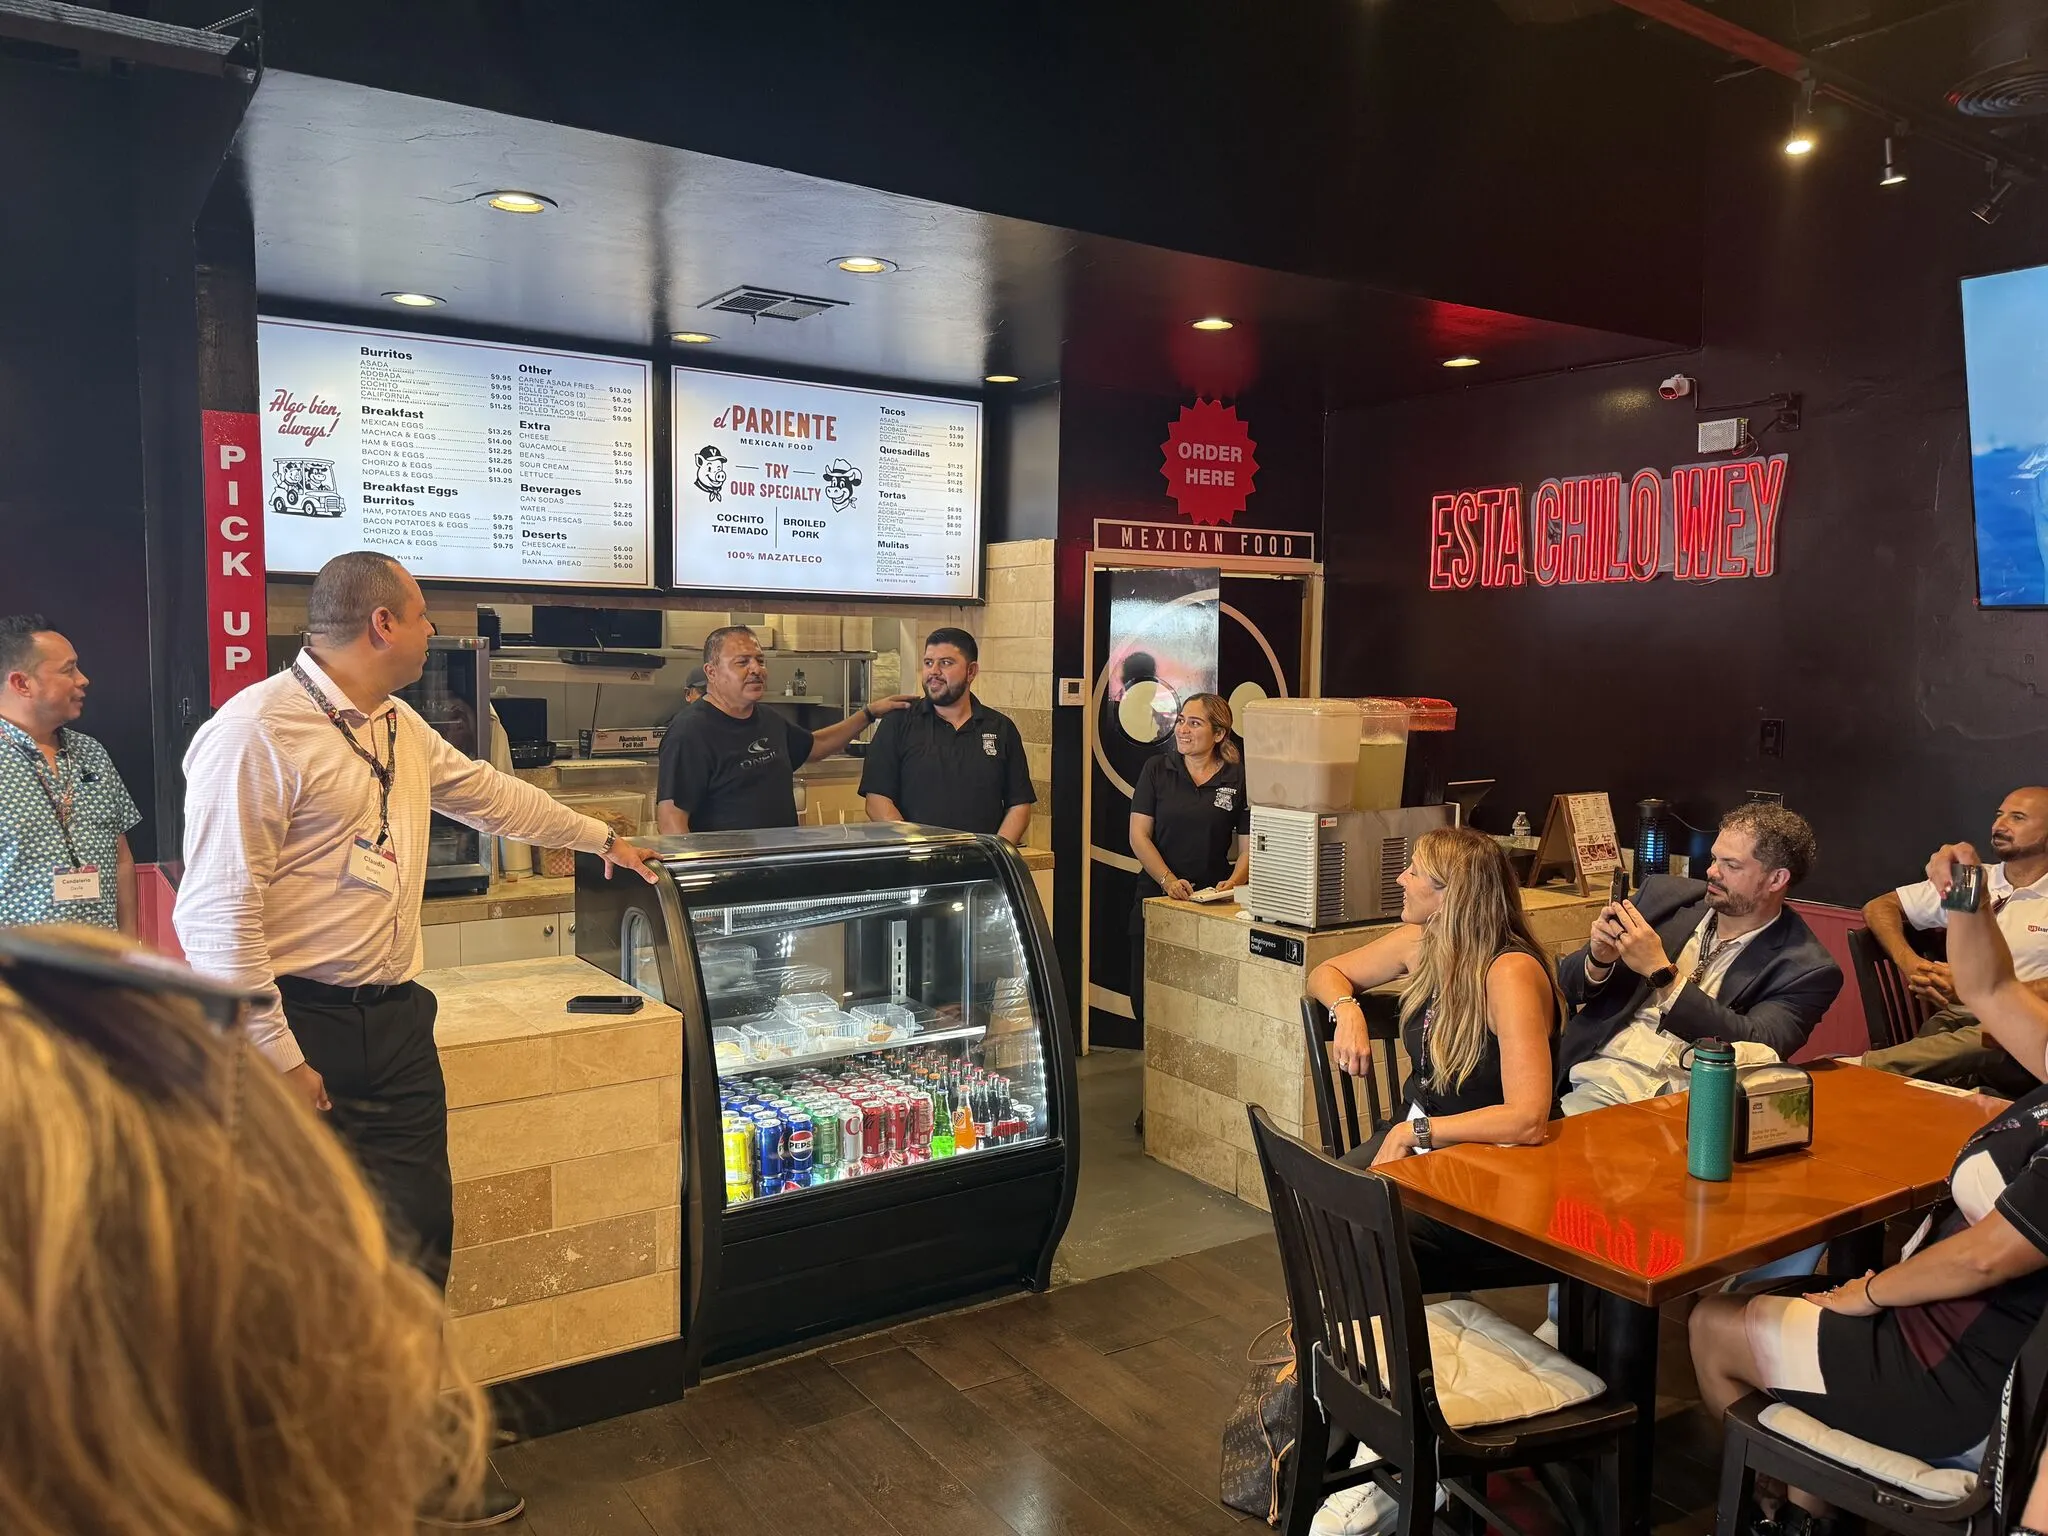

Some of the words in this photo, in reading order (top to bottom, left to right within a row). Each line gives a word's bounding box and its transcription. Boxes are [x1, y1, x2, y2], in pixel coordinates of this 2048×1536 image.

[360, 347, 412, 360] Burritos
[360, 360, 389, 368] ASADA
[360, 370, 401, 379] ADOBADA
[519, 364, 552, 375] Other
[360, 380, 398, 389] COCHITO
[519, 376, 545, 384] CARNE
[574, 382, 595, 390] FRIES
[361, 390, 410, 400] CALIFORNIA
[519, 386, 548, 394] ROLLED
[519, 396, 548, 404] ROLLED
[269, 389, 307, 422] Algo
[309, 395, 341, 417] bien,
[519, 405, 548, 413] ROLLED
[361, 406, 424, 419] Breakfast
[880, 407, 906, 416] Tacos
[361, 419, 399, 427] MEXICAN
[519, 421, 551, 431] Extra
[713, 408, 730, 428] el
[732, 405, 837, 441] PARIENTE
[278, 416, 339, 447] always!
[361, 429, 403, 437] MACHACA
[519, 442, 567, 451] GUACAMOLE
[740, 438, 784, 448] MEXICAN
[788, 442, 813, 451] FOOD
[362, 449, 391, 457] BACON
[402, 451, 425, 459] EGGS
[880, 446, 930, 457] Quesadillas
[1178, 442, 1242, 463] ORDER
[362, 459, 399, 467] CHORIZO
[362, 469, 400, 477] NOPALES
[520, 471, 553, 479] LETTUCE
[765, 463, 789, 479] TRY
[1185, 468, 1235, 487] HERE
[363, 482, 425, 493] Breakfast
[428, 486, 458, 497] Eggs
[521, 484, 581, 496] Beverages
[731, 481, 755, 496] OUR
[760, 484, 822, 502] SPECIALTY
[879, 490, 906, 499] Tortas
[363, 495, 415, 506] Burritos
[219, 444, 252, 577] PICK
[386, 509, 427, 517] POTATOES
[395, 519, 436, 527] POTATOES
[717, 513, 764, 524] COCHITO
[783, 518, 826, 528] BROILED
[1429, 487, 1523, 589] ESTA
[1534, 472, 1662, 586] CHILO
[1672, 459, 1784, 579] WEY
[522, 530, 567, 540] Deserts
[712, 525, 768, 536] TATEMADO
[792, 530, 819, 539] PORK
[878, 541, 909, 549] Mulitas
[1121, 527, 1223, 552] MEXICAN
[1241, 534, 1292, 556] FOOD
[727, 551, 754, 560] 100%
[758, 553, 822, 563] MAZATLECO
[223, 611, 252, 671] UP
[364, 856, 385, 868] Claudio
[1251, 936, 1276, 948] Employees
[1251, 943, 1262, 952] Only
[790, 1142, 812, 1150] PEPS
